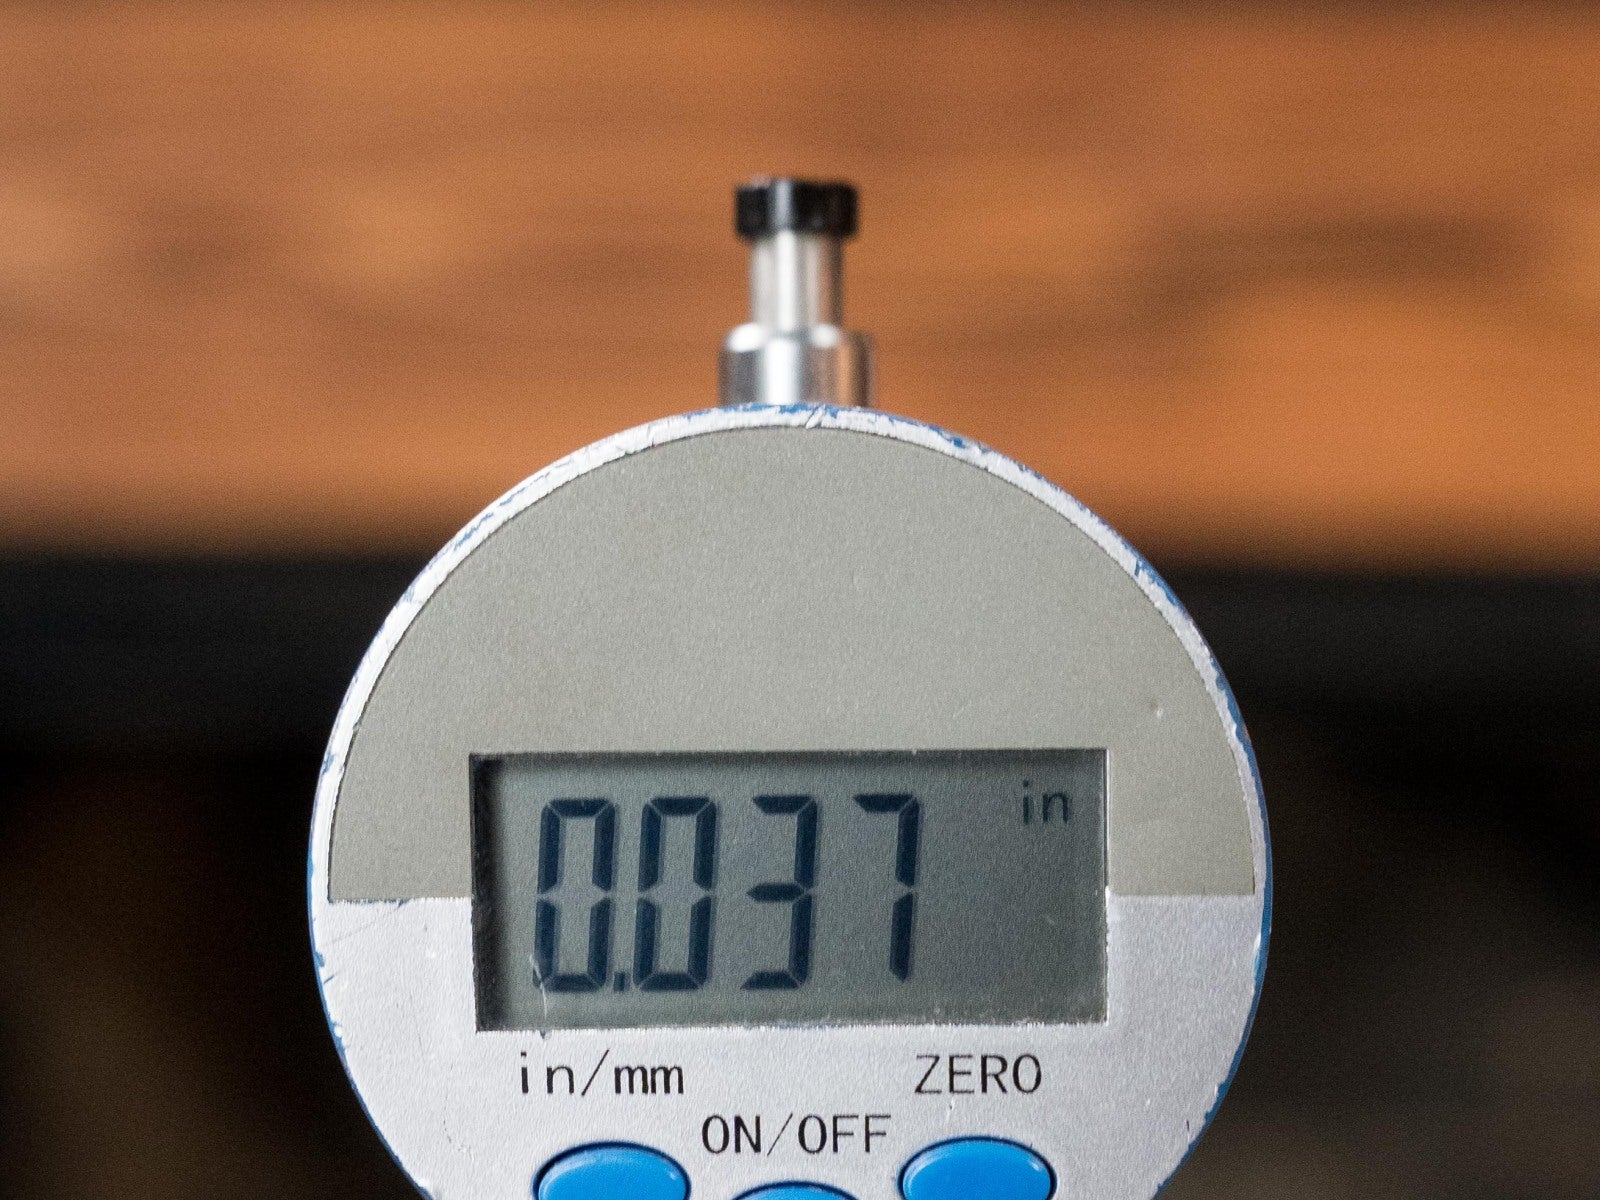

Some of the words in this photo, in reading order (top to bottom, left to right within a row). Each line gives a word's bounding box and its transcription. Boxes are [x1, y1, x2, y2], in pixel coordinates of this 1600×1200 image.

[1021, 779, 1074, 824] in
[532, 793, 922, 993] 0.037
[519, 1048, 685, 1098] in/mm
[913, 1053, 1043, 1096] ZERO
[701, 1112, 892, 1156] ON/OFF
